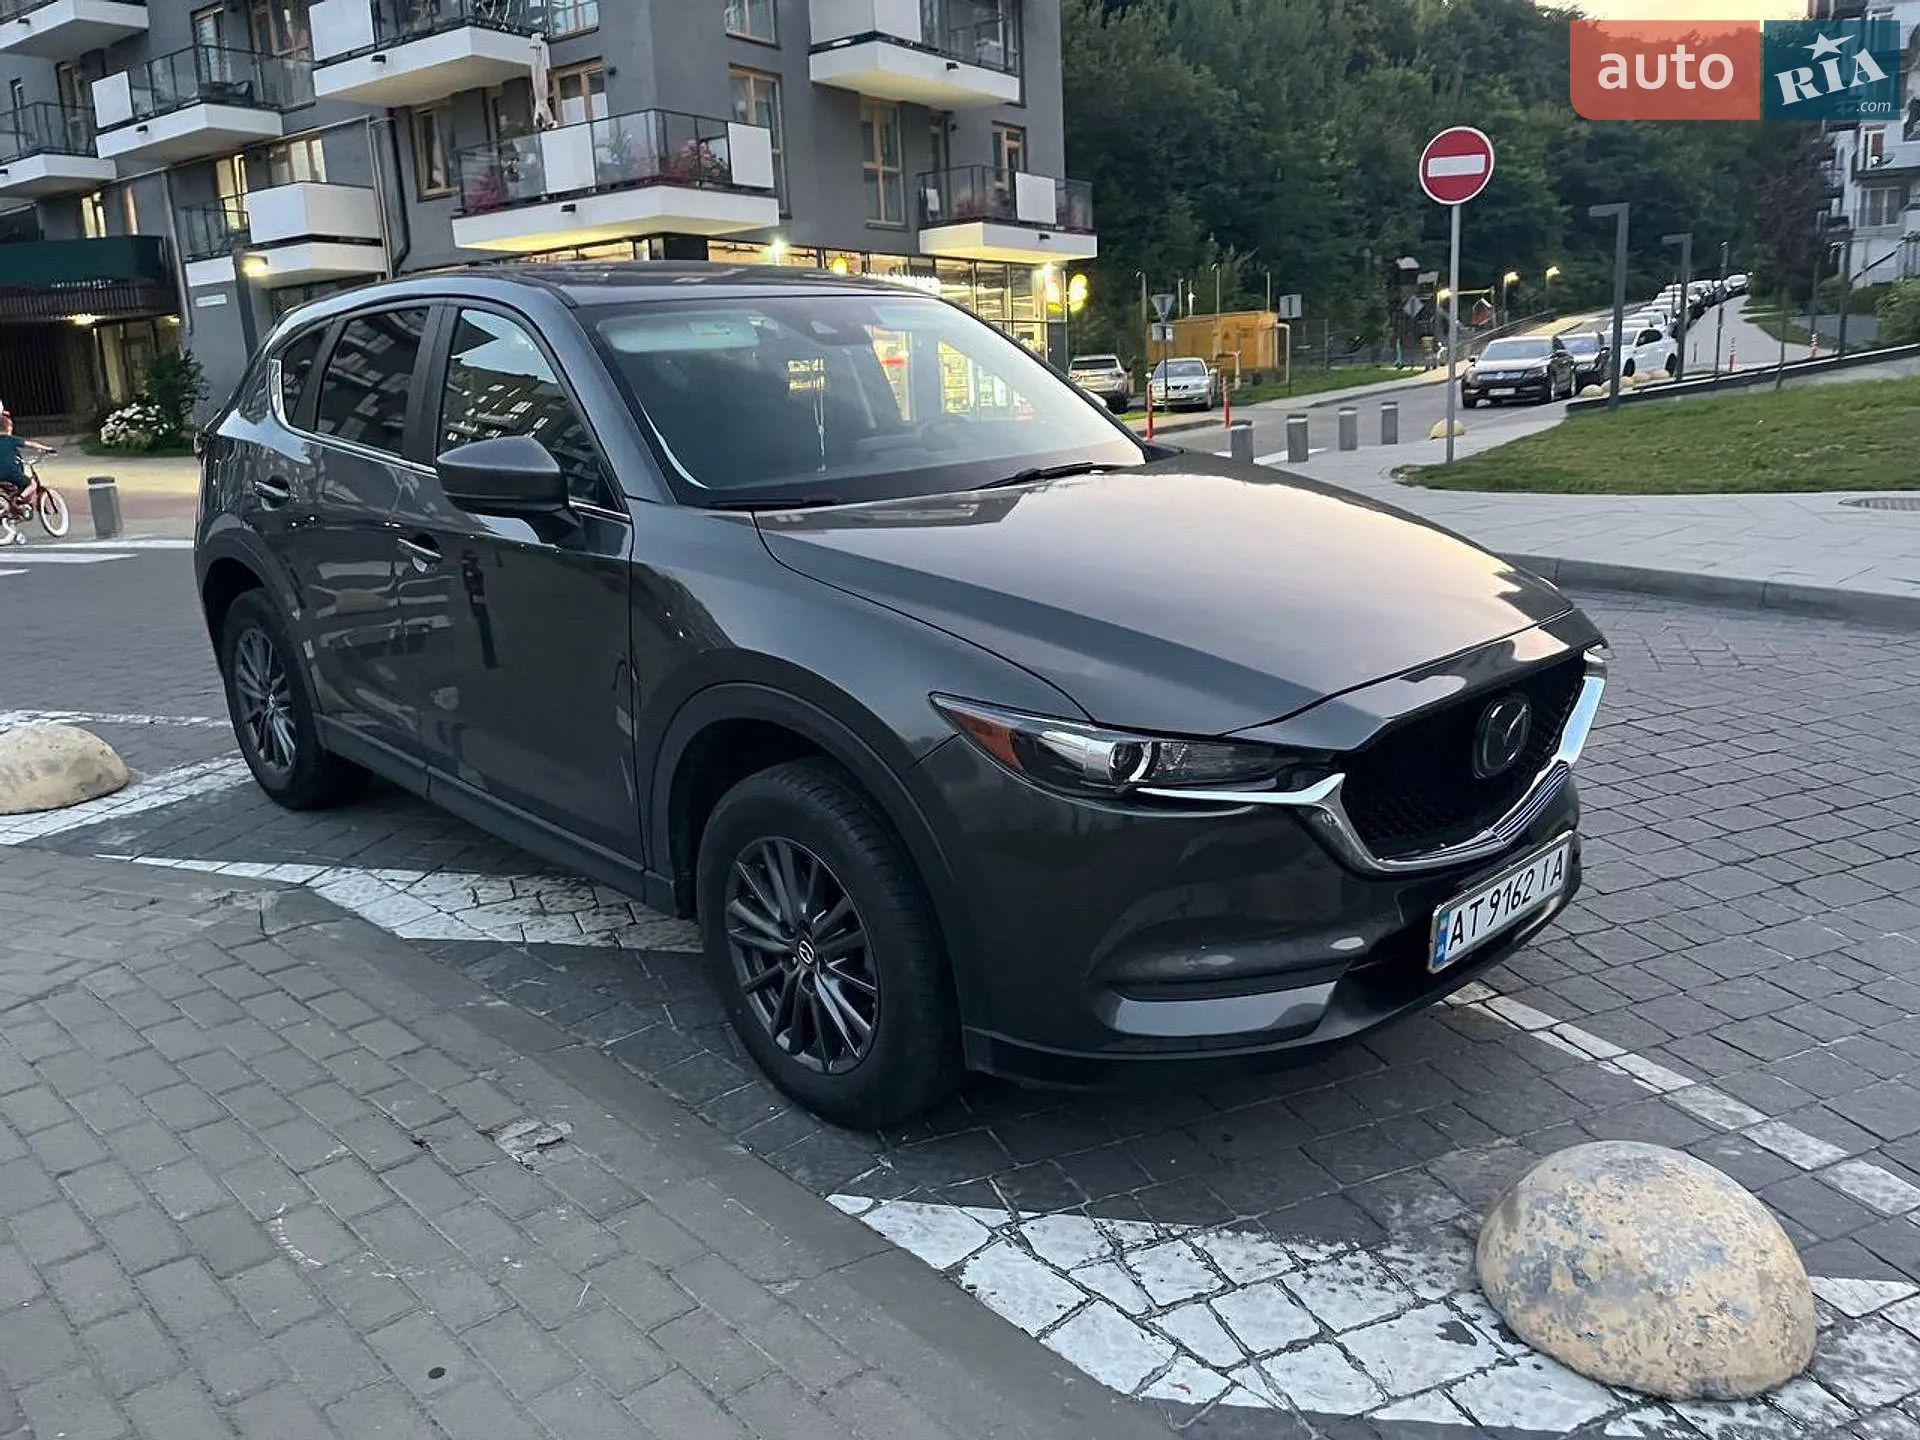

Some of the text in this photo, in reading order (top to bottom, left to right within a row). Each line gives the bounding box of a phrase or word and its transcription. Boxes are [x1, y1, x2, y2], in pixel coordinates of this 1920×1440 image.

[1448, 850, 1563, 950] AT 9162 IA
